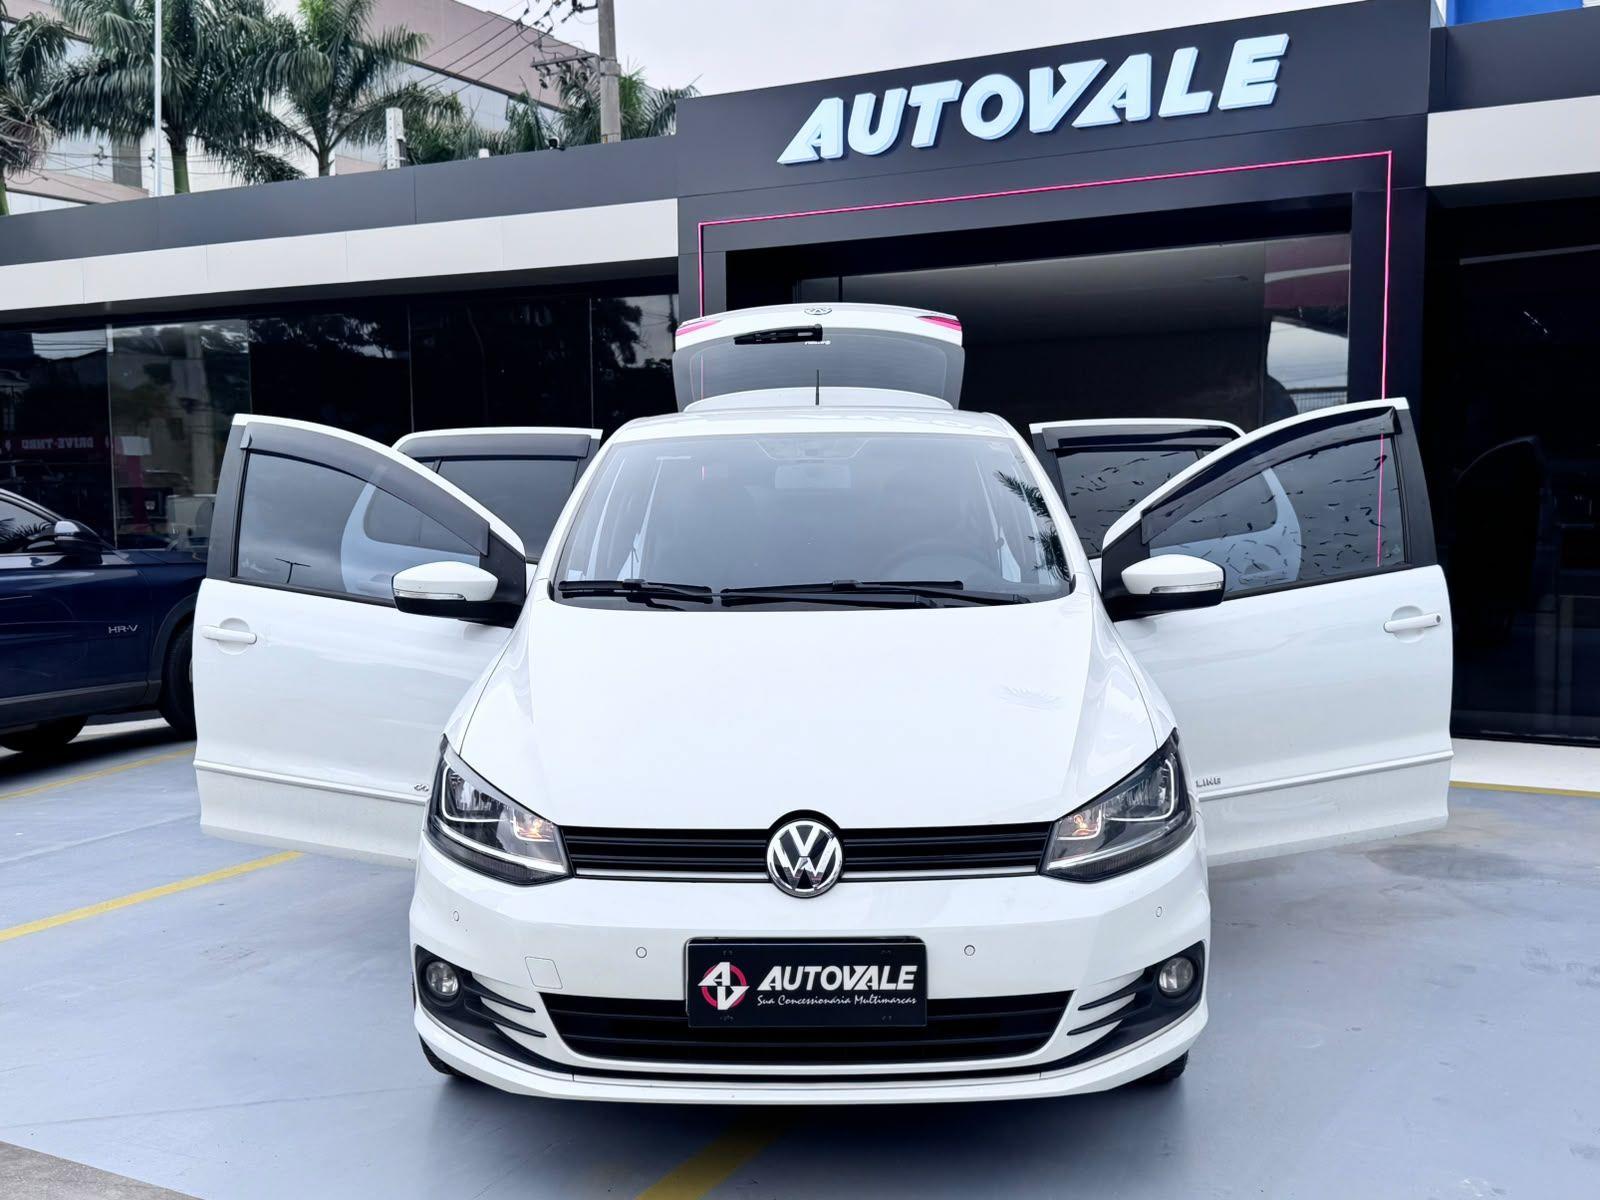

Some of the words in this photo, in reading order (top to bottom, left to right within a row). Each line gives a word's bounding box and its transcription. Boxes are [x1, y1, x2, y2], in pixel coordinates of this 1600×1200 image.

[777, 33, 1290, 164] AUTOVALE
[769, 822, 840, 894] VW
[756, 994, 775, 1006] Sua
[853, 994, 918, 1006] Multimarcas
[757, 965, 918, 991] AUTOVALE
